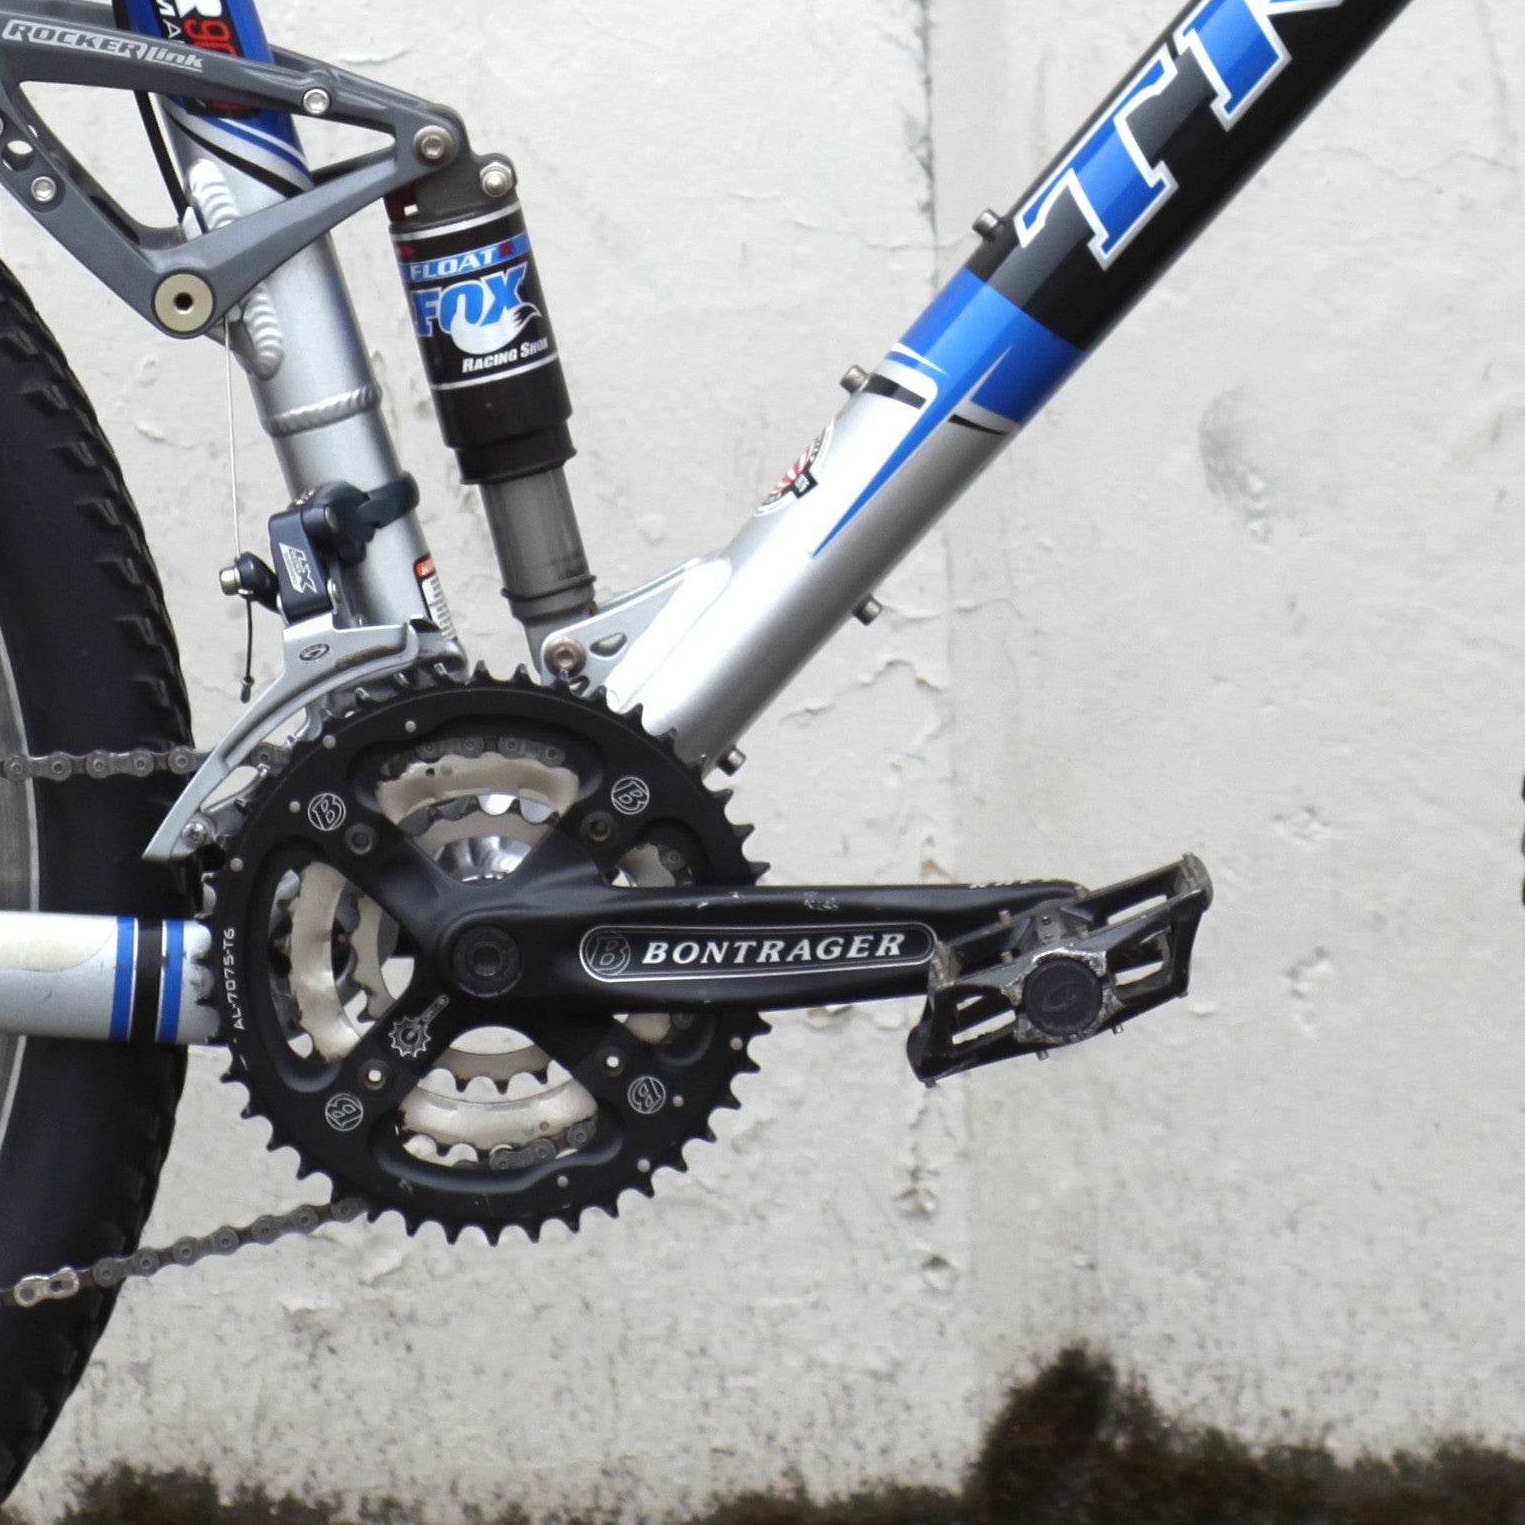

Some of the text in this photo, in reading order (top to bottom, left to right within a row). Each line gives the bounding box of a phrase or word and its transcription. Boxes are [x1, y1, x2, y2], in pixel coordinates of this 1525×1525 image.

[409, 247, 498, 279] FLOAT
[409, 260, 528, 337] FOX
[462, 348, 518, 374] RACING
[641, 932, 906, 965] BONTRAGER
[222, 927, 247, 1031] AL-7075-T6
